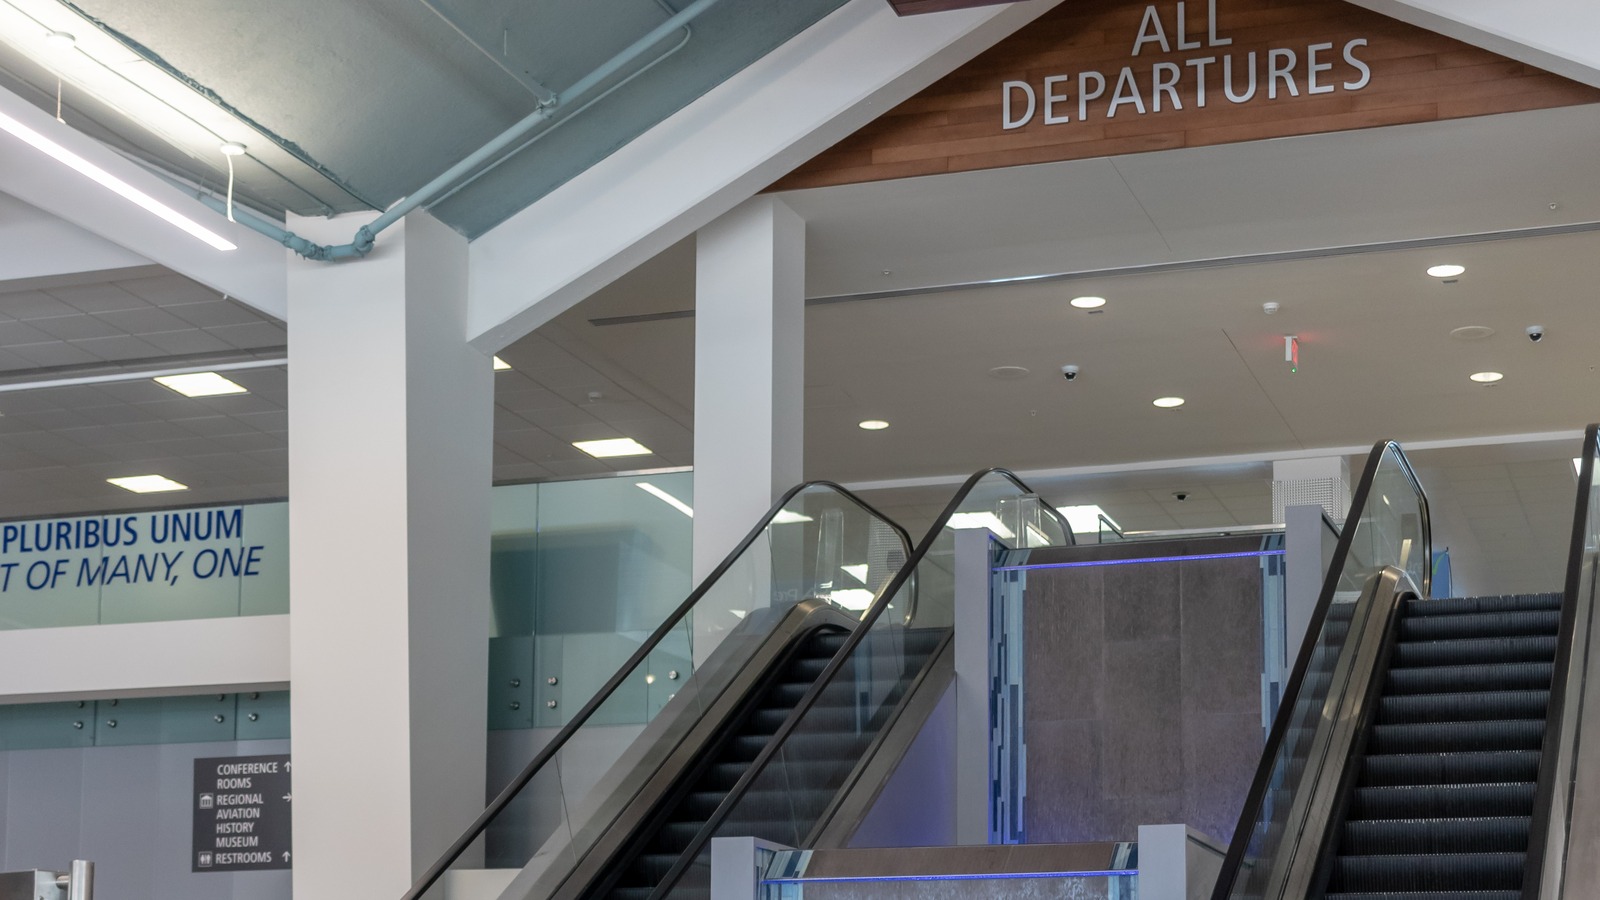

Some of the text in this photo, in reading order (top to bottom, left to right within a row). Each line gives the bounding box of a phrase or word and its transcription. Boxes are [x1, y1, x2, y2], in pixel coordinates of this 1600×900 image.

[1131, 0, 1233, 56] ALL
[1002, 38, 1372, 130] DEPARTURES
[2, 508, 242, 553] PLURIBUS UNUM
[26, 558, 70, 590] OF
[76, 550, 184, 587] MANY,
[193, 545, 265, 580] ONE
[216, 762, 278, 776] CONFERENCE
[216, 777, 252, 790] ROOMS
[216, 793, 264, 805] REGIONAL
[216, 807, 260, 819] AVIATION
[216, 822, 255, 834] HISTORY
[215, 836, 259, 848] MUSEUM
[215, 851, 272, 864] RESTROOMS
